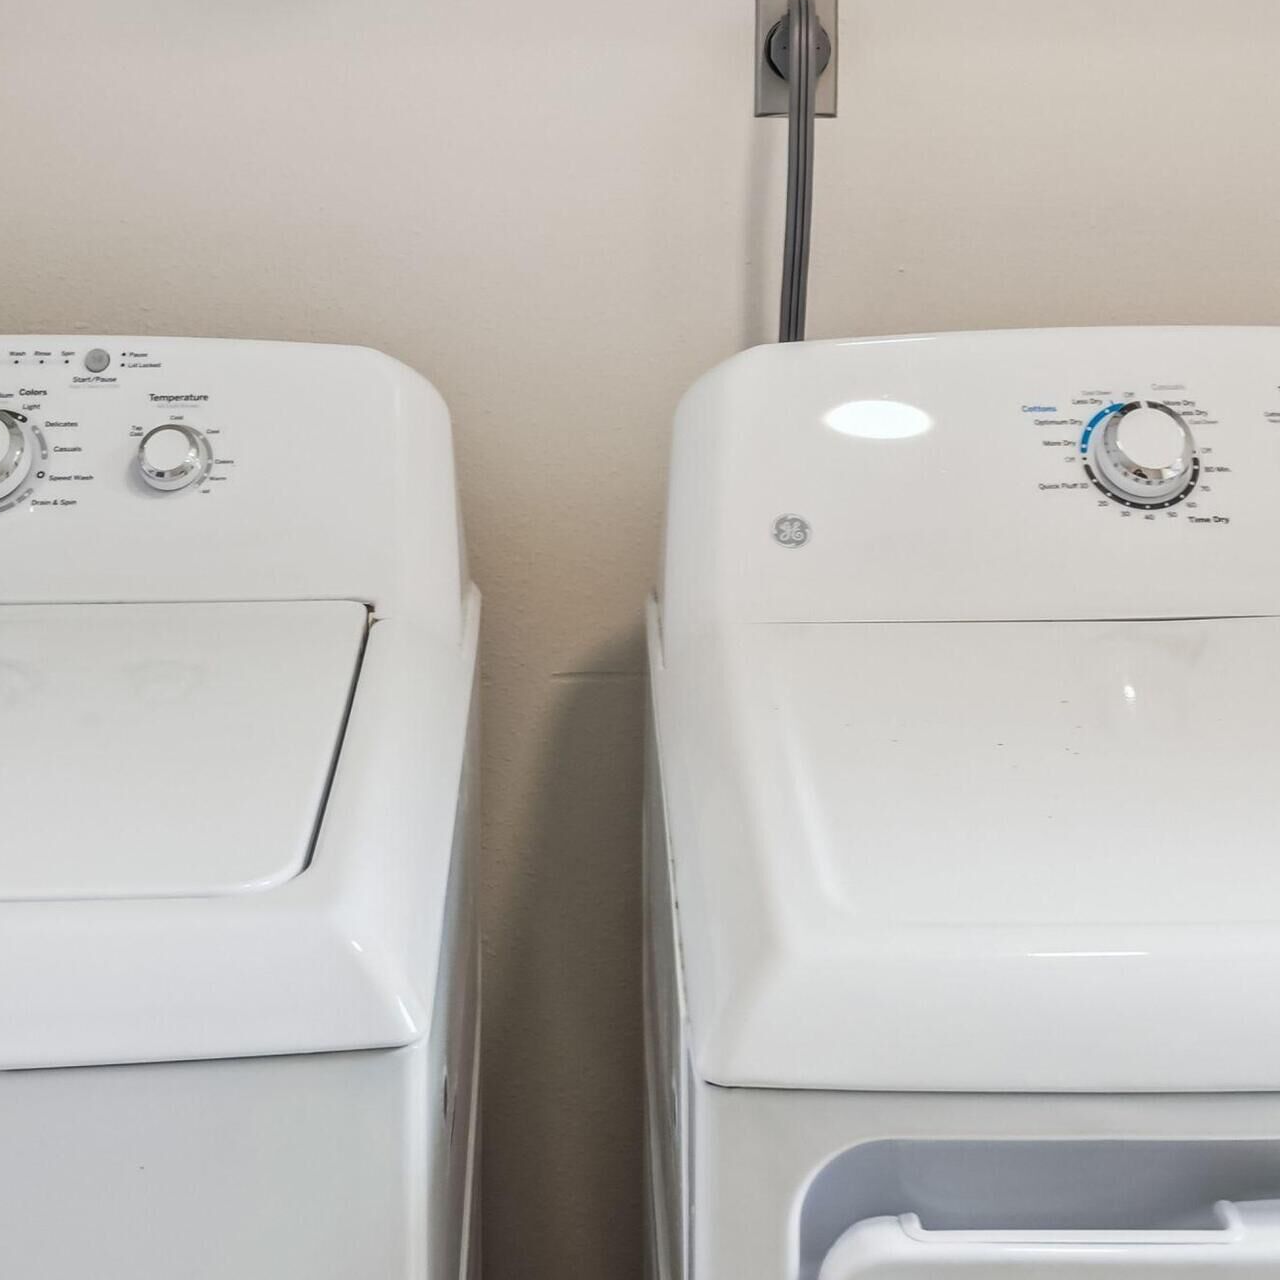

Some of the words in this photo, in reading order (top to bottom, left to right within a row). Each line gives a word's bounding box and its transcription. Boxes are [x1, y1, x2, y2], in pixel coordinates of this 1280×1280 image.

[72, 376, 118, 384] Start/Pause
[18, 388, 48, 396] Colors
[148, 393, 209, 403] Temperature
[1022, 405, 1057, 413] Cottons
[1188, 515, 1211, 523] Time
[1211, 515, 1230, 524] Dry
